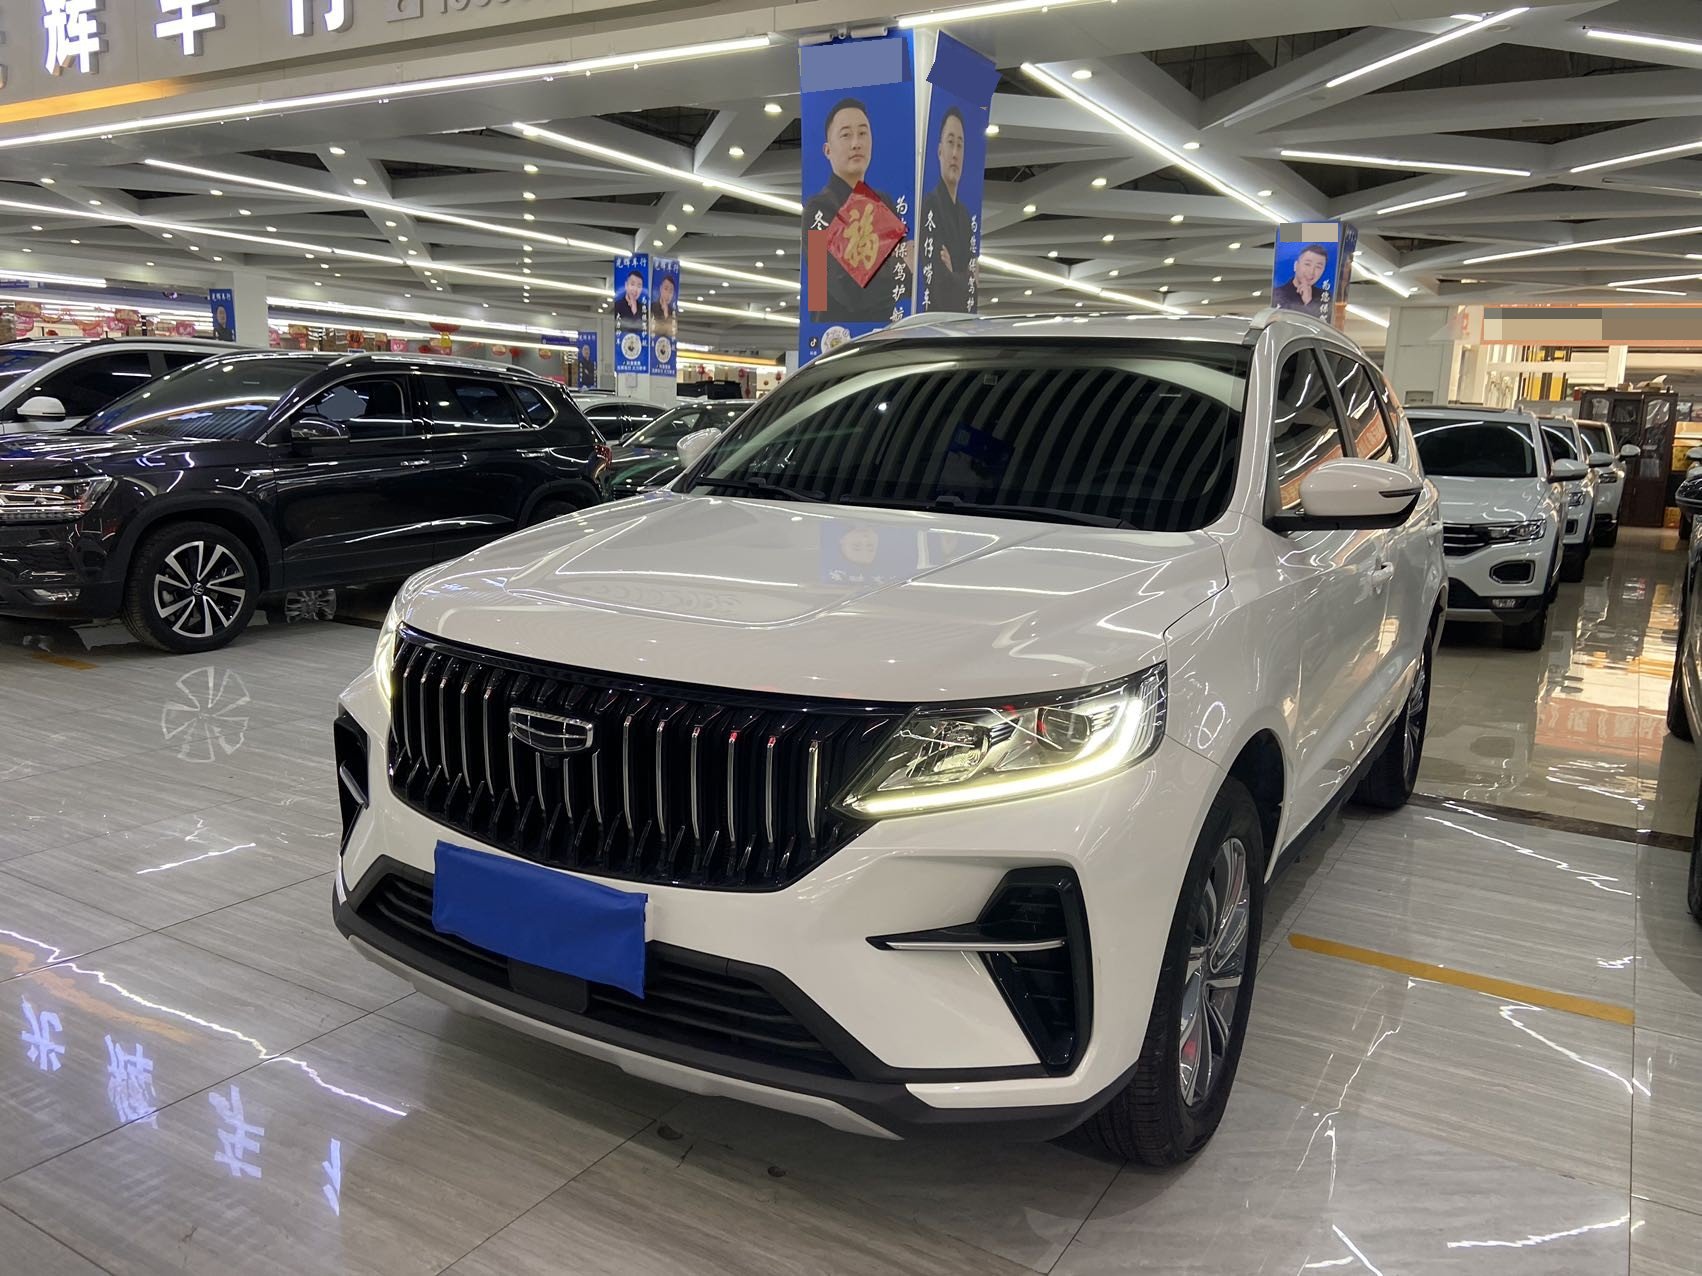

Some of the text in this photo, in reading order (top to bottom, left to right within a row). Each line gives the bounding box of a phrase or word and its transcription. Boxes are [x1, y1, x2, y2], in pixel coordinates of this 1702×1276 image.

[843, 202, 880, 271] 福
[890, 195, 909, 323] 为保驾护航
